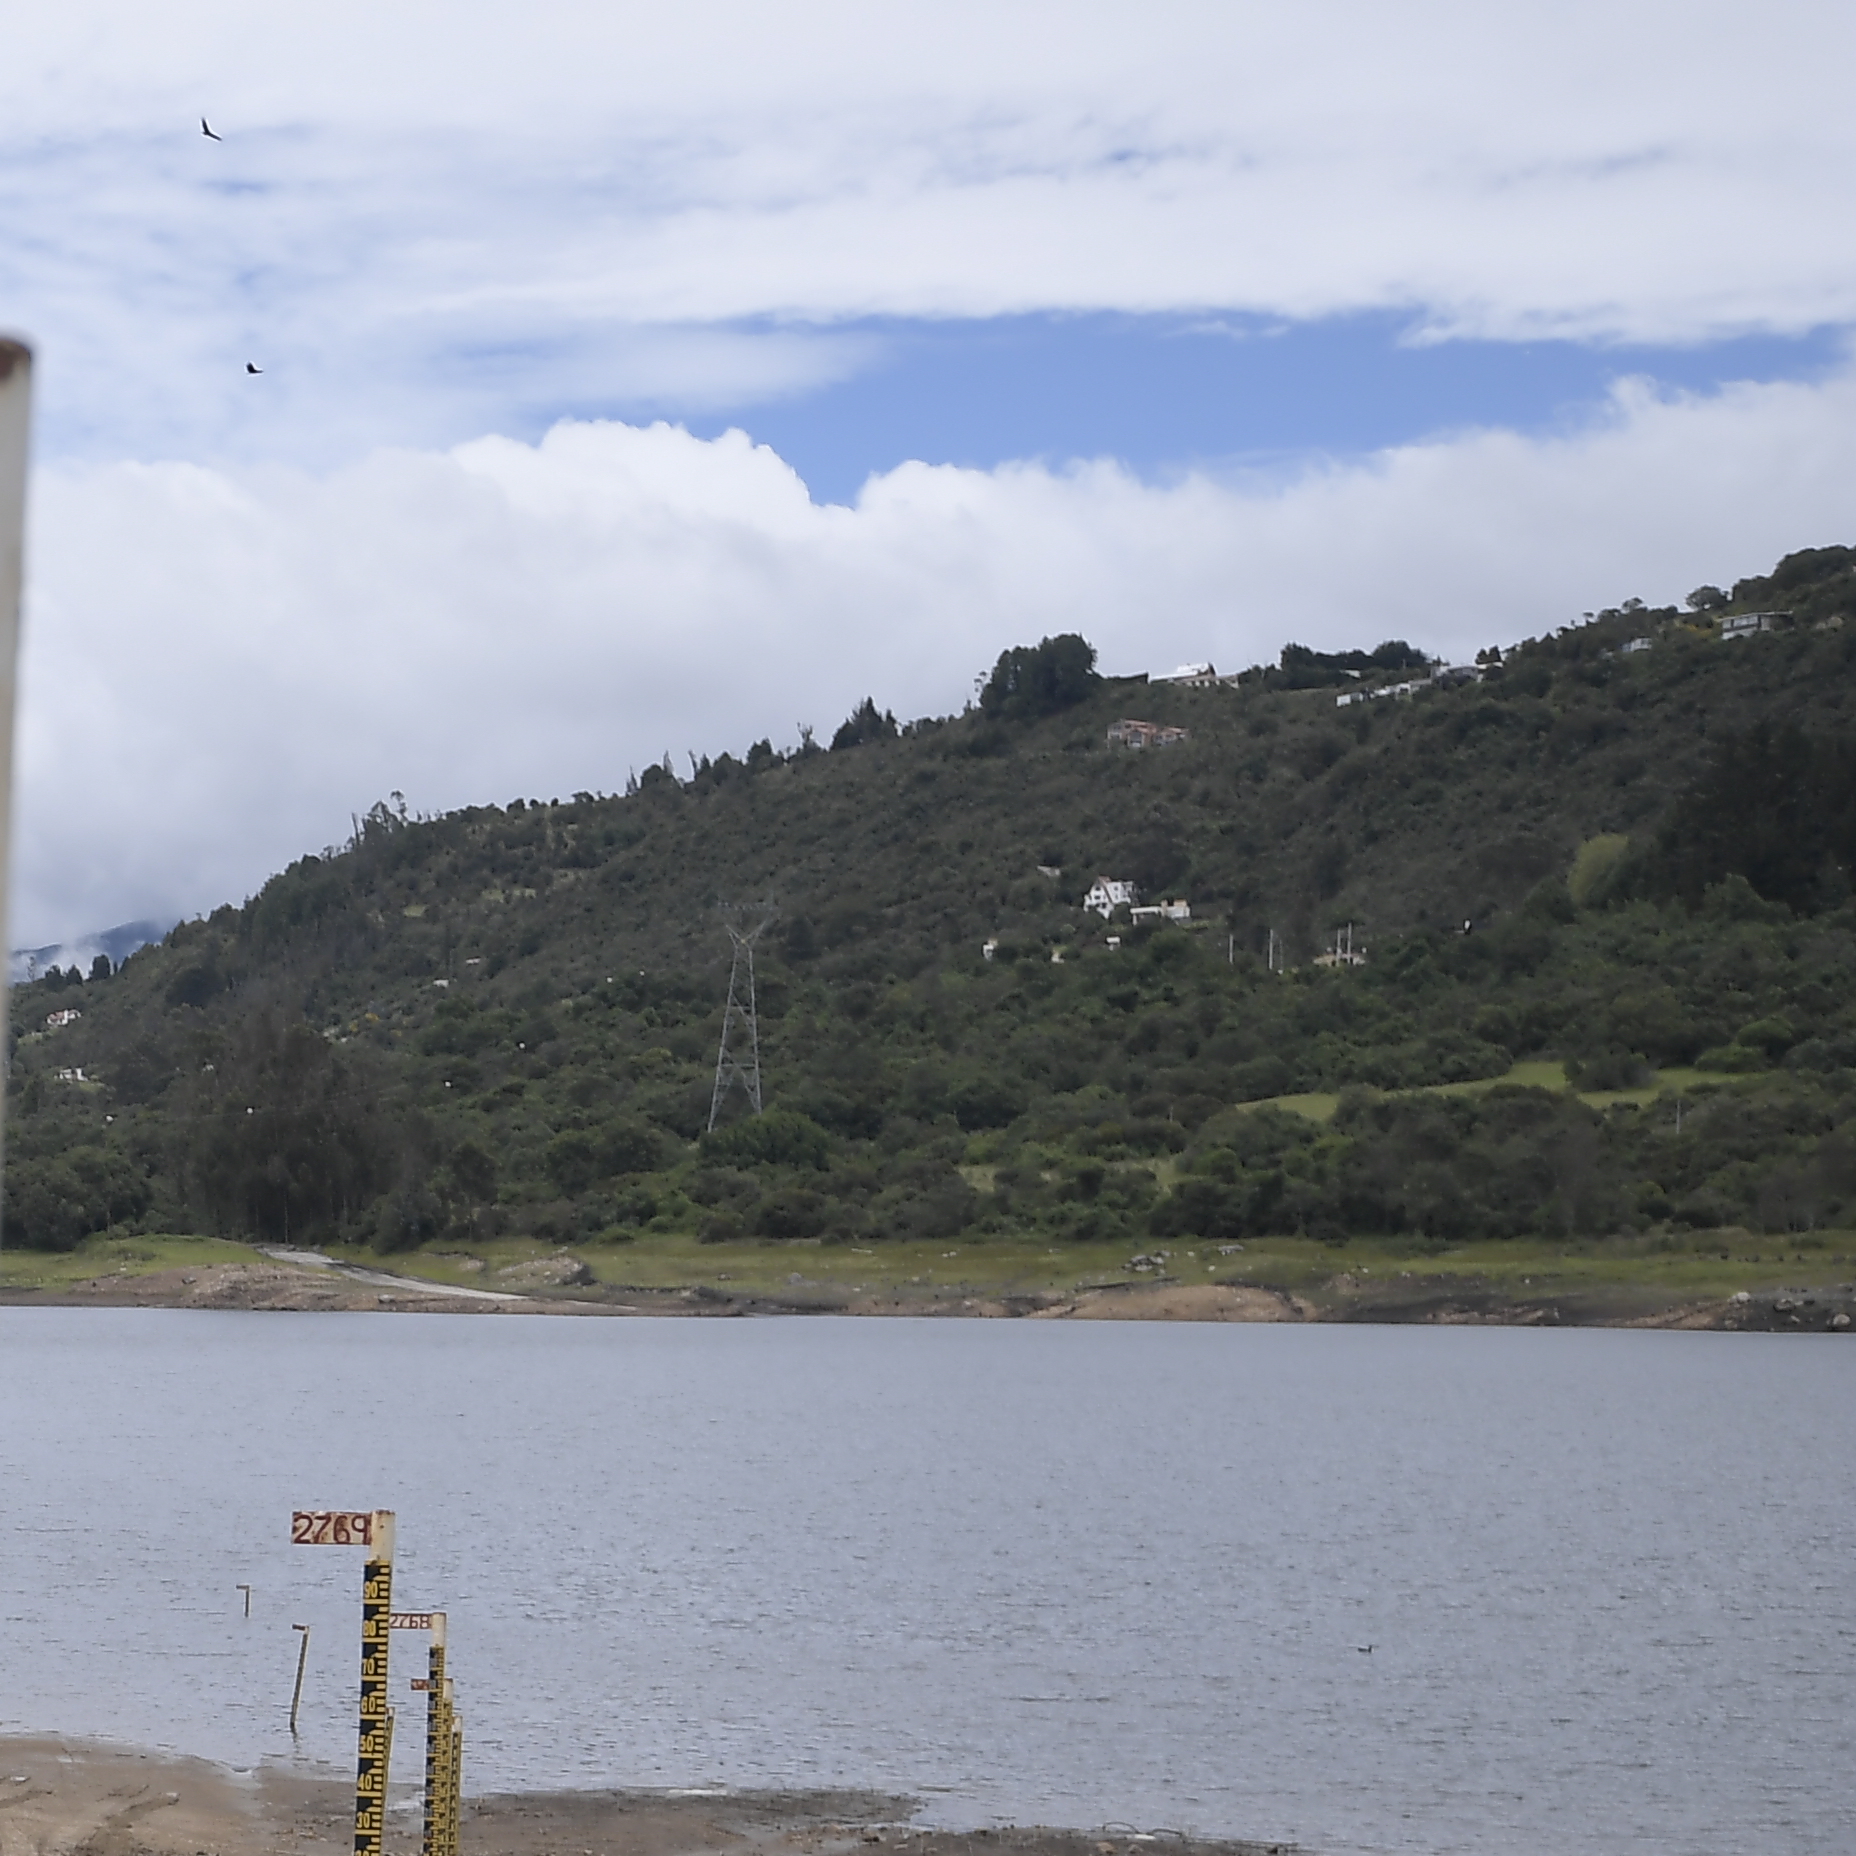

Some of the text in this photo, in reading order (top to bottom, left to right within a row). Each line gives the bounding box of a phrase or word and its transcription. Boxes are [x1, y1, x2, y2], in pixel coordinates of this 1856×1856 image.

[294, 1514, 369, 1545] 2769
[364, 1581, 378, 1598] 90
[390, 1614, 429, 1629] 2768
[361, 1696, 376, 1713] 60
[360, 1735, 374, 1752] 50
[357, 1773, 372, 1790] 40
[356, 1811, 370, 1829] 30
